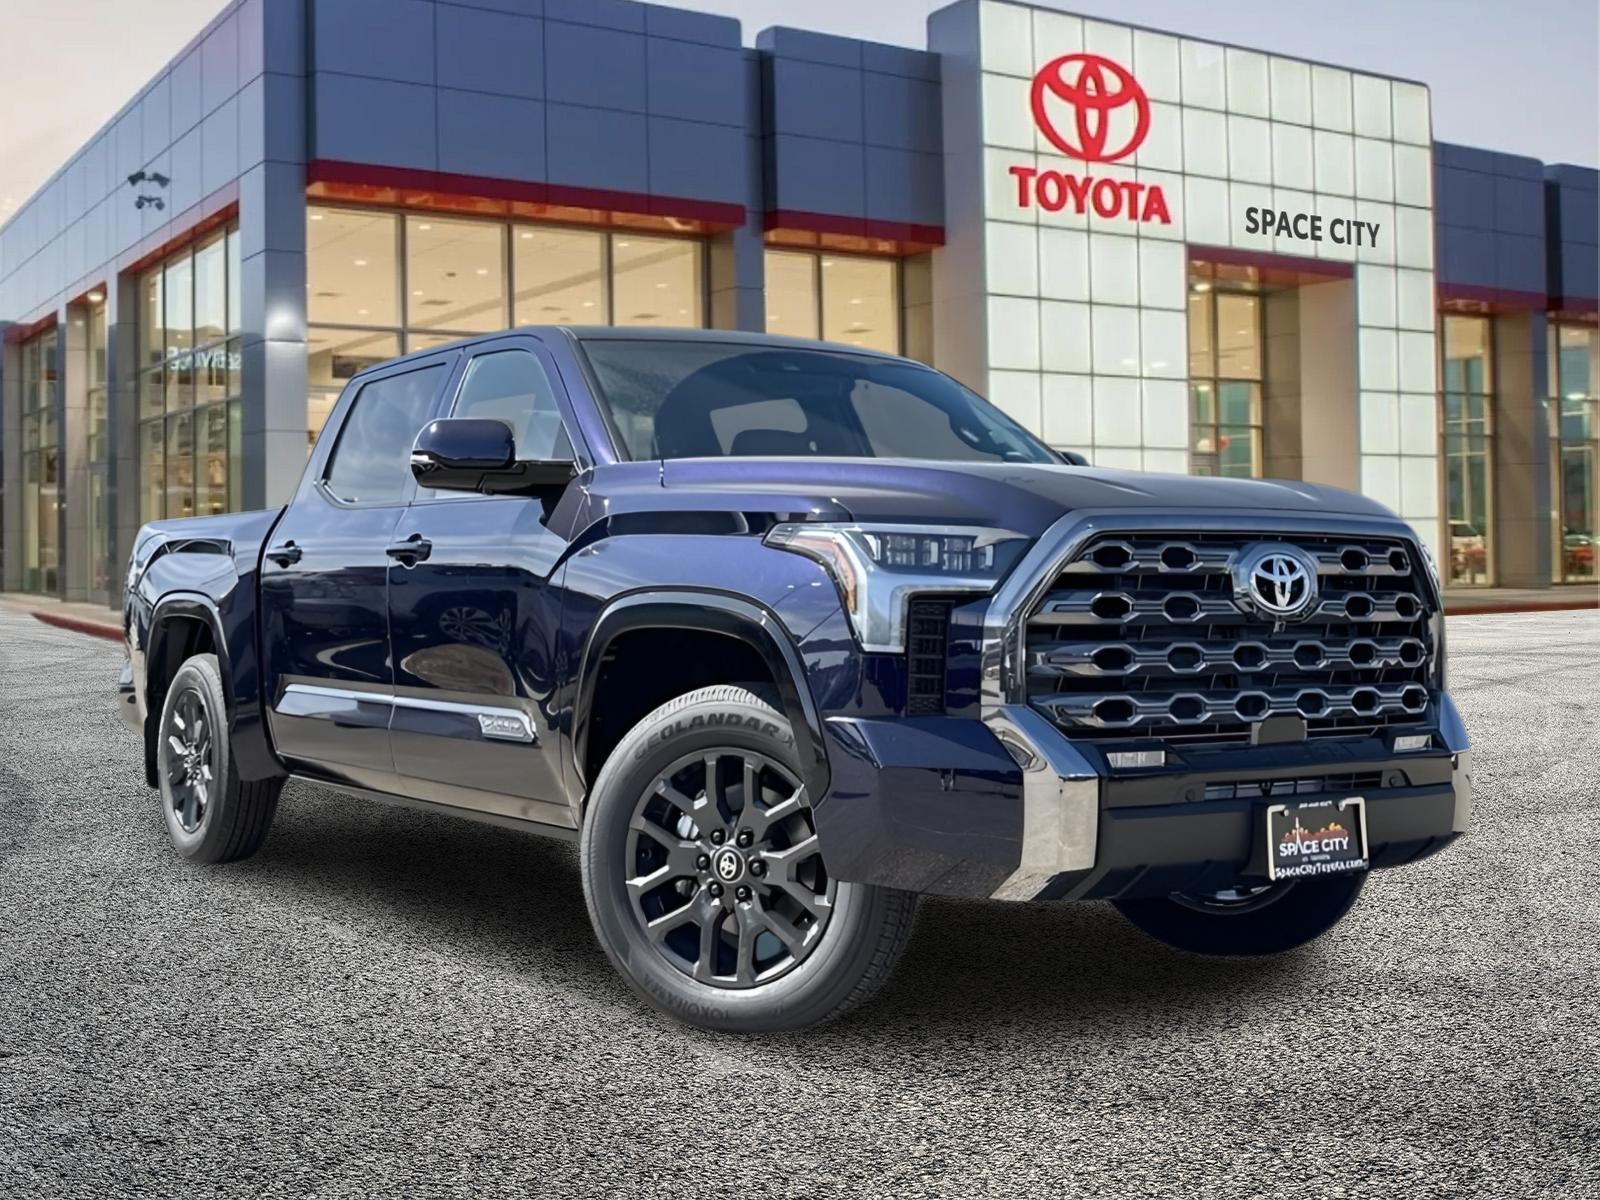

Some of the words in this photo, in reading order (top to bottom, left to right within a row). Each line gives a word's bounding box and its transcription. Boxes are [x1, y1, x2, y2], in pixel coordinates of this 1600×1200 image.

[1009, 166, 1171, 224] TOYOTA
[1245, 206, 1323, 241] SPACE
[1329, 217, 1381, 248] CITY
[1279, 838, 1320, 856] SPACE
[1321, 837, 1349, 851] CITY
